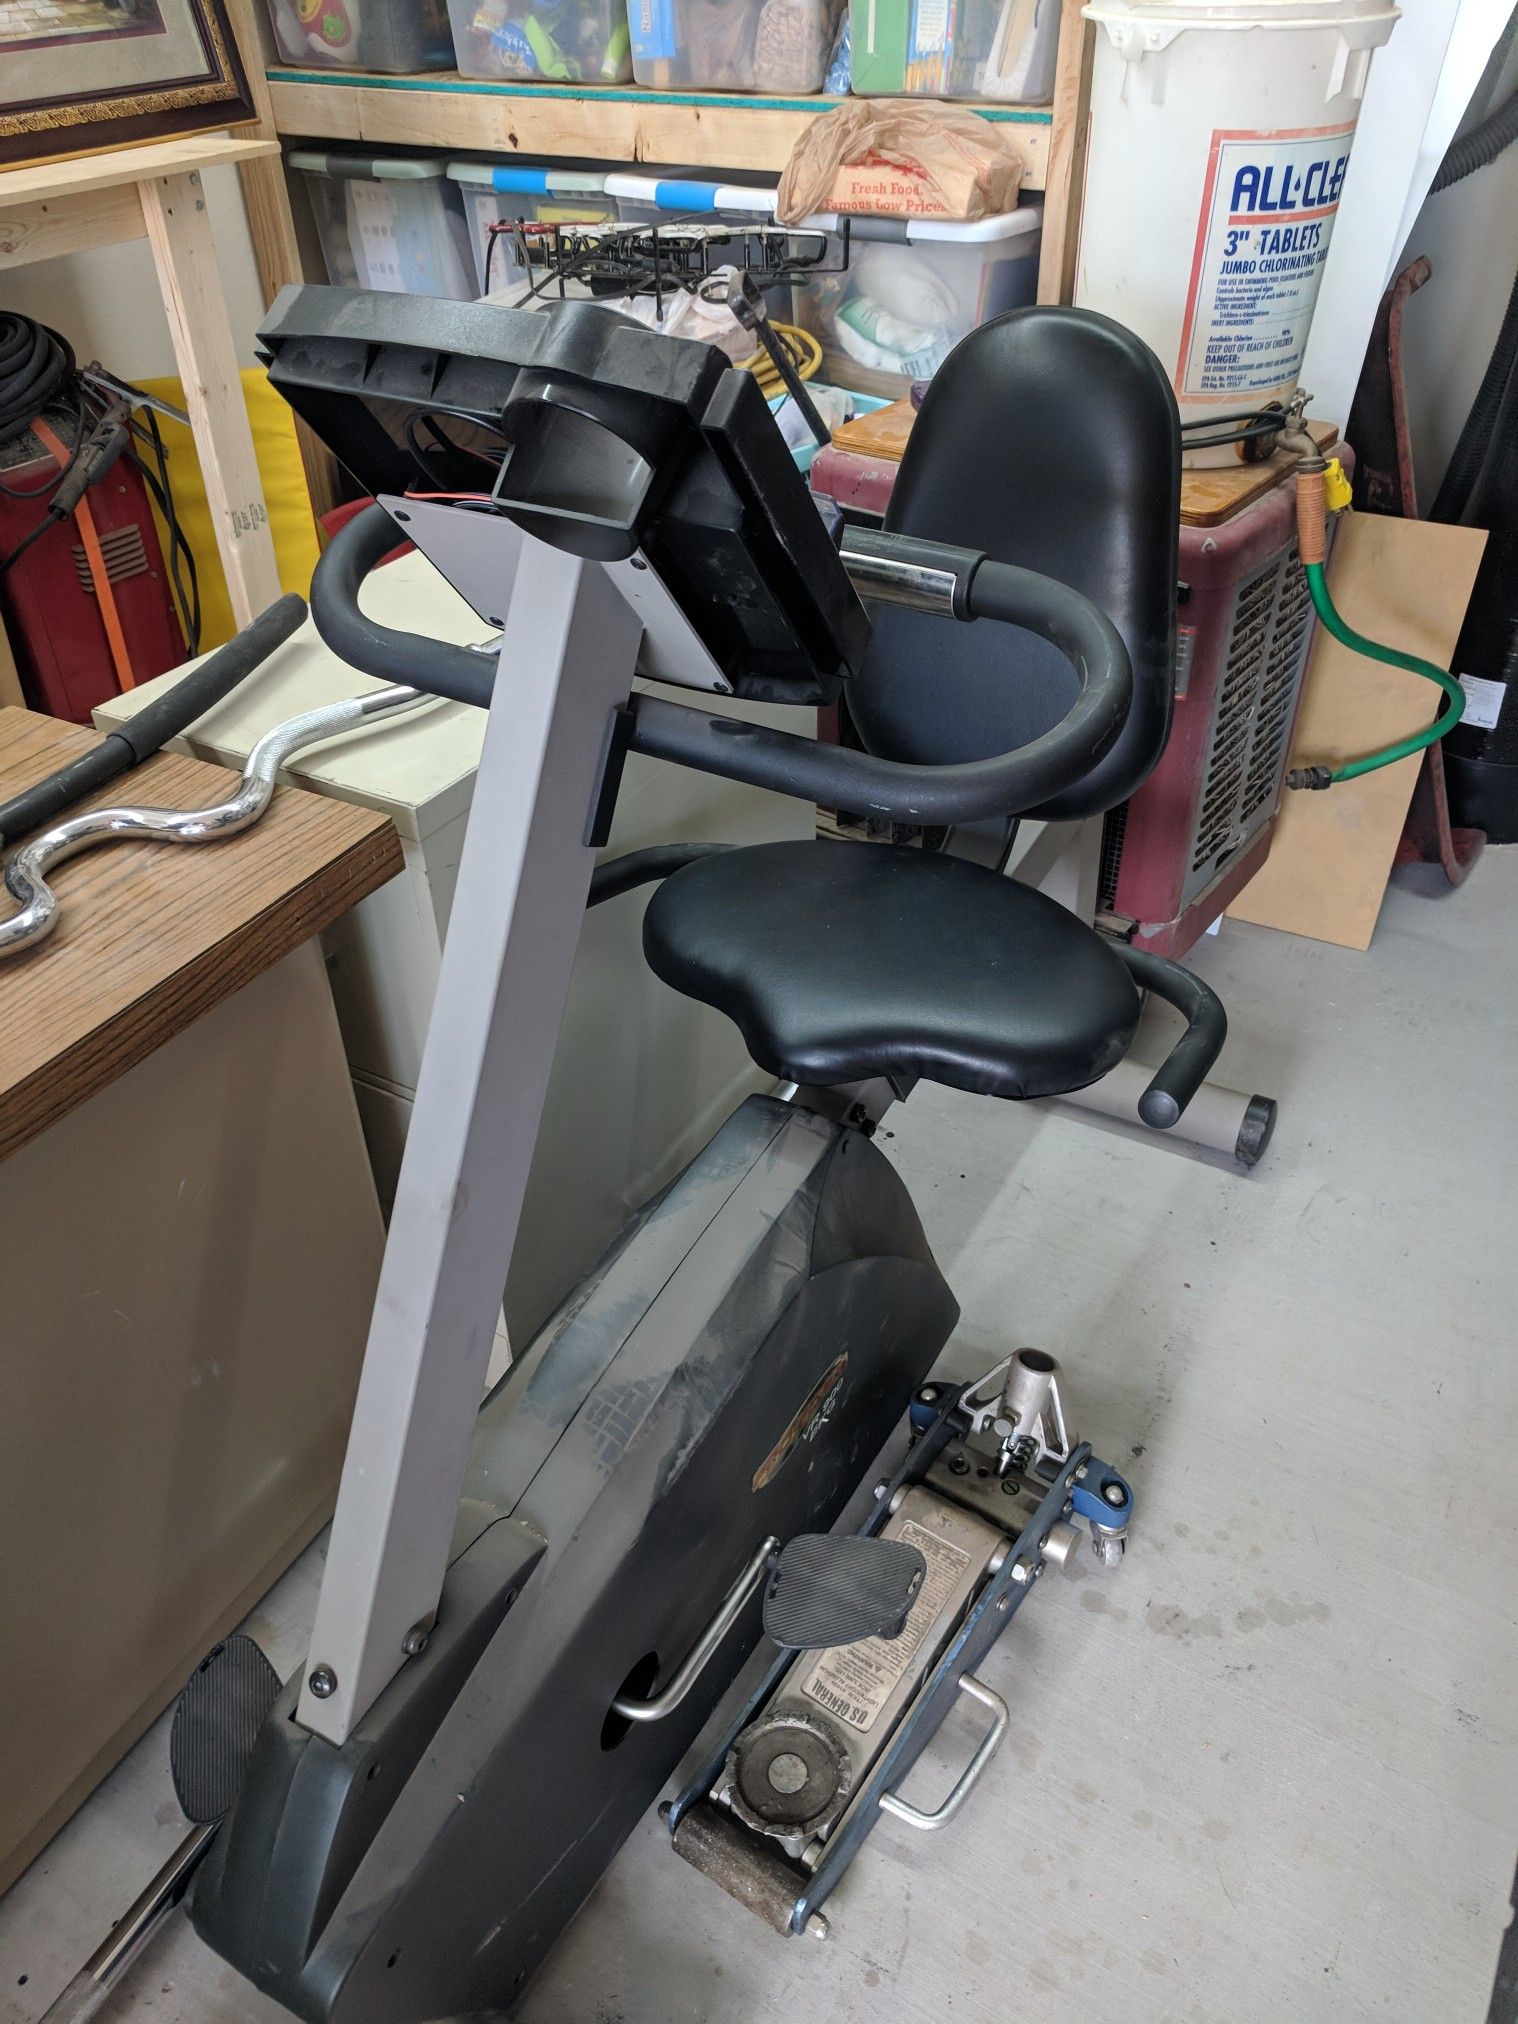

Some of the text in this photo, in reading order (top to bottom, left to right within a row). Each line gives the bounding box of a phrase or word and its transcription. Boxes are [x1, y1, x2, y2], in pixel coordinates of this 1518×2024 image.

[851, 182, 887, 195] Fresh
[824, 199, 872, 210] Famous
[876, 199, 903, 210] Low
[1224, 222, 1323, 256] 3" TABLETS
[1220, 259, 1256, 274] JUMBO
[1259, 252, 1316, 273] CHLORINATING
[1207, 345, 1222, 353] KEEP
[1224, 344, 1236, 353] OUT
[1237, 344, 1245, 352] OF
[1246, 341, 1263, 352] REACH
[1265, 340, 1272, 349] OF
[1205, 355, 1240, 364] DANGER:
[847, 1649, 874, 1669] WARNING
[811, 1677, 851, 1717] GENERAL
